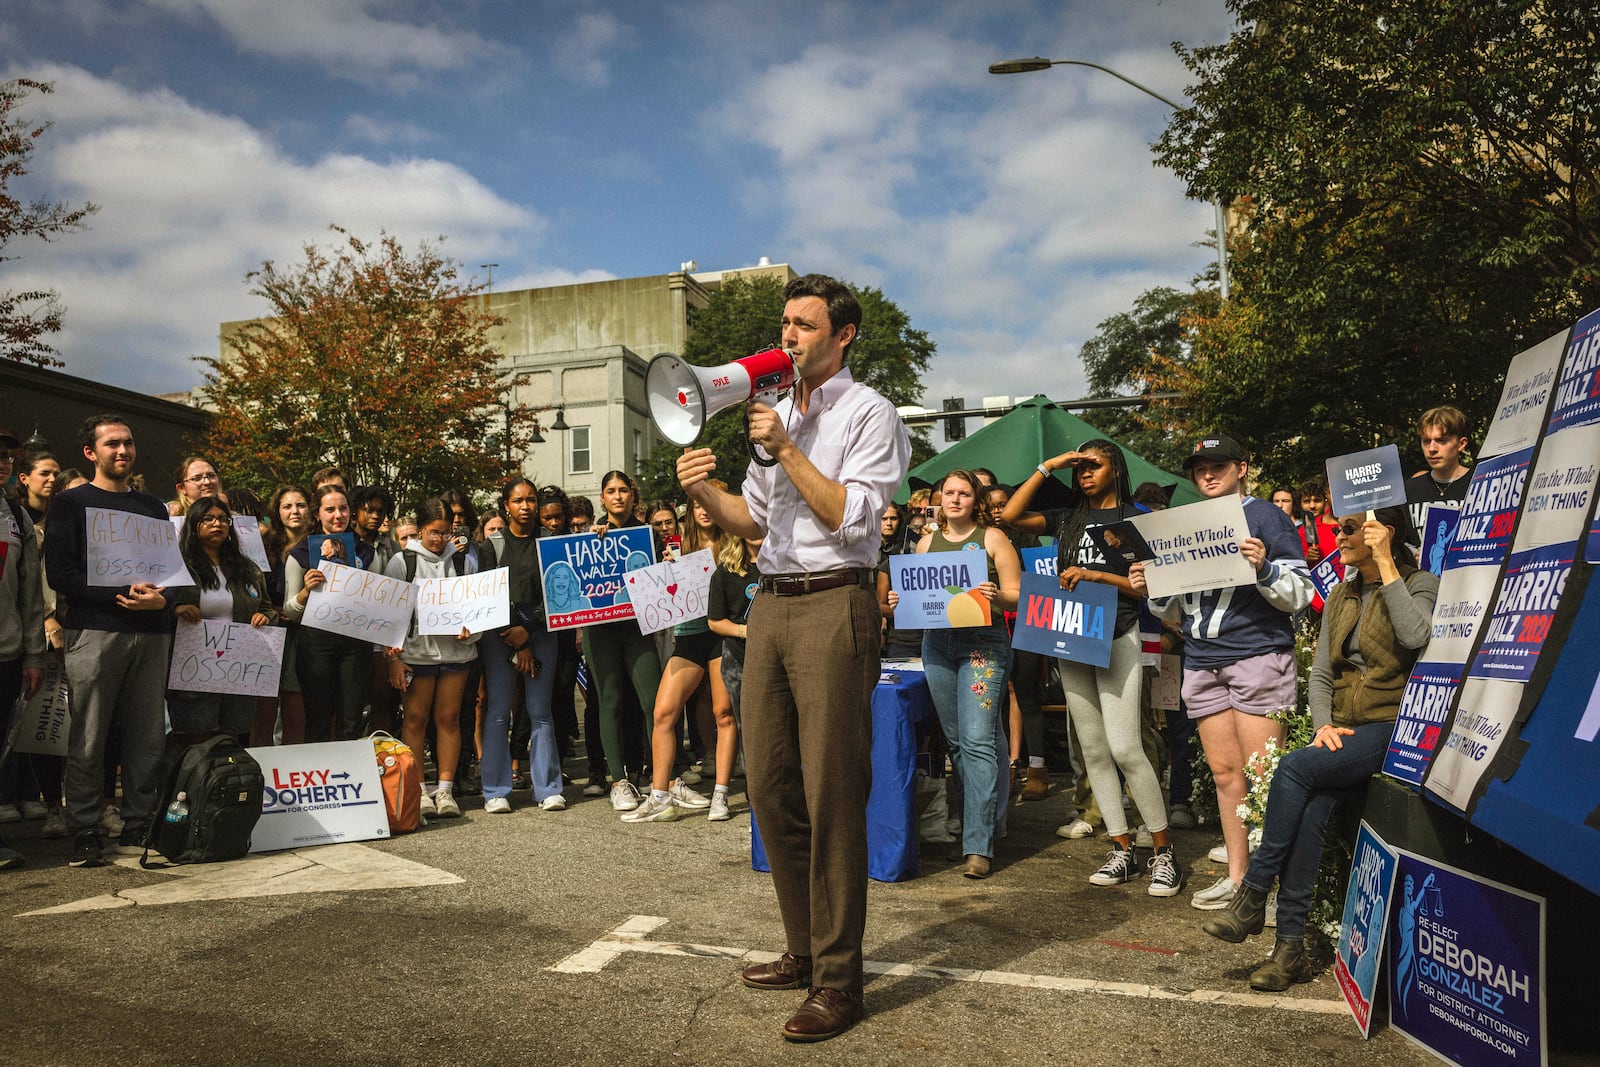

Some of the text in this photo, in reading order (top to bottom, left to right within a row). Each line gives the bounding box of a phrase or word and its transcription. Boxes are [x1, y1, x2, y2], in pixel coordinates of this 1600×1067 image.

[712, 376, 731, 388] PYLE
[1530, 367, 1554, 391] Whole
[1554, 372, 1592, 412] WALZ
[1499, 390, 1547, 420] DEM THING
[1345, 462, 1382, 480] HARRIS
[1352, 475, 1379, 485] WALZ
[1547, 470, 1564, 488] the
[1564, 465, 1595, 486] Whole
[1461, 469, 1528, 517] HARRIS
[1528, 491, 1588, 513] DEM THING
[92, 511, 174, 545] GEORGIA
[1147, 526, 1234, 552] Win the Whole
[1456, 515, 1492, 542] WALZ
[565, 535, 631, 567] HARRIS
[1073, 547, 1106, 564] ALZ
[1154, 552, 1186, 567] DEM
[1188, 542, 1239, 561] THING
[96, 557, 167, 577] OSSOFF
[579, 564, 621, 581] WALZ
[644, 561, 686, 588] WE
[901, 564, 972, 591] GEORGIA
[421, 570, 508, 606] GEORGIA
[585, 580, 623, 598] 2024
[314, 602, 393, 632] OSSOFF
[427, 606, 496, 627] OSSOFF
[645, 584, 710, 630] OSSOF
[922, 601, 945, 611] HARRIS
[1026, 594, 1104, 640] KAMALA
[1457, 601, 1482, 617] Whole
[204, 622, 239, 650] WE
[1432, 622, 1473, 638] DEM THING
[1484, 614, 1521, 643] WALZ
[181, 654, 272, 683] OSSOFF
[35, 696, 54, 741] THING
[1471, 714, 1502, 740] Whole
[1395, 719, 1426, 747] WALZ
[272, 768, 330, 789] LEXY
[287, 802, 341, 814] FOR CONGRESS
[1418, 916, 1459, 941] RE-ELECT
[1418, 928, 1529, 1004] DEBORAH
[1419, 956, 1504, 1014] GONZALEZ
[1418, 981, 1530, 1046] FOR DISTRICT ATTORNEY
[1429, 1004, 1516, 1058] DEBORAHFORDA.COM
